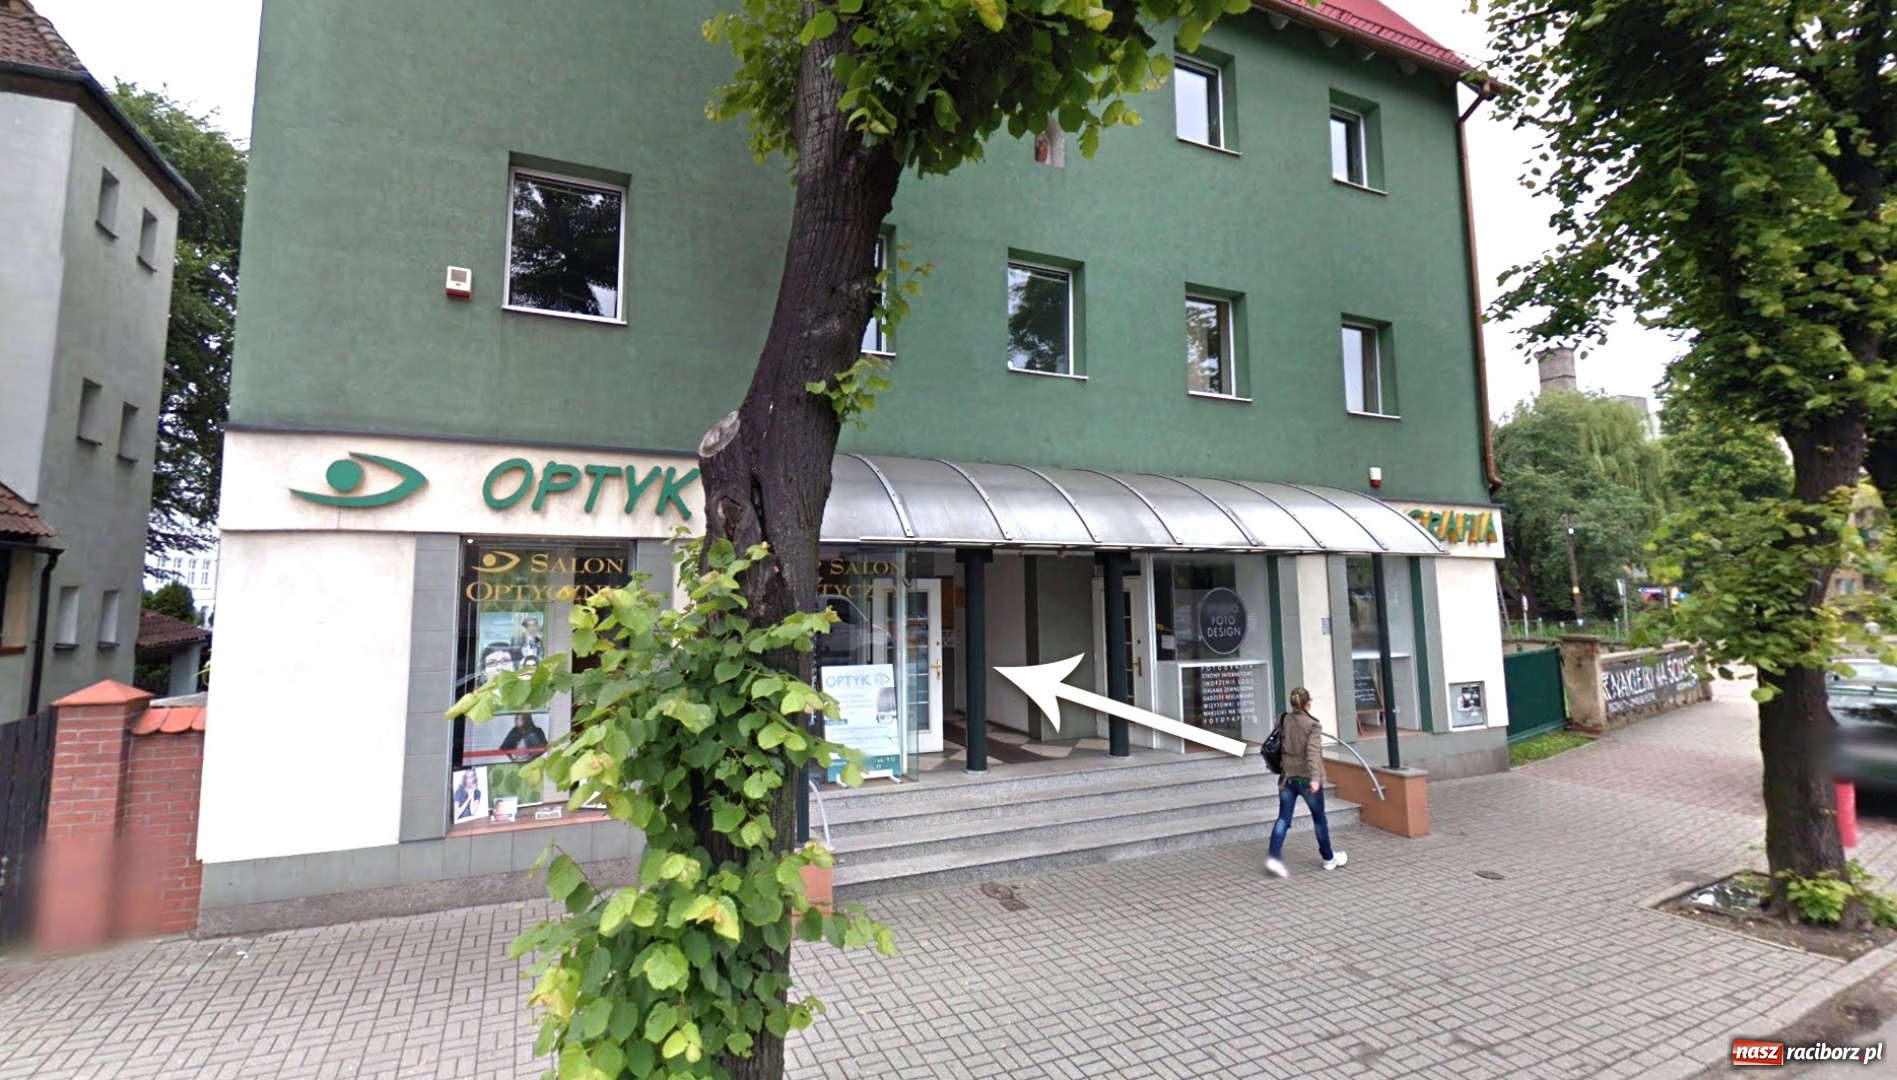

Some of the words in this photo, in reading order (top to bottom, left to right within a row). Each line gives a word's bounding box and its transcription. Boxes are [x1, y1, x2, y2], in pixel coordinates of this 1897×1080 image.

[482, 457, 701, 520] OPTYK
[530, 553, 626, 573] SALON
[830, 558, 903, 575] SALON
[1211, 615, 1236, 626] FOTO
[1207, 626, 1241, 638] DESIGN
[825, 674, 872, 688] OPTYK
